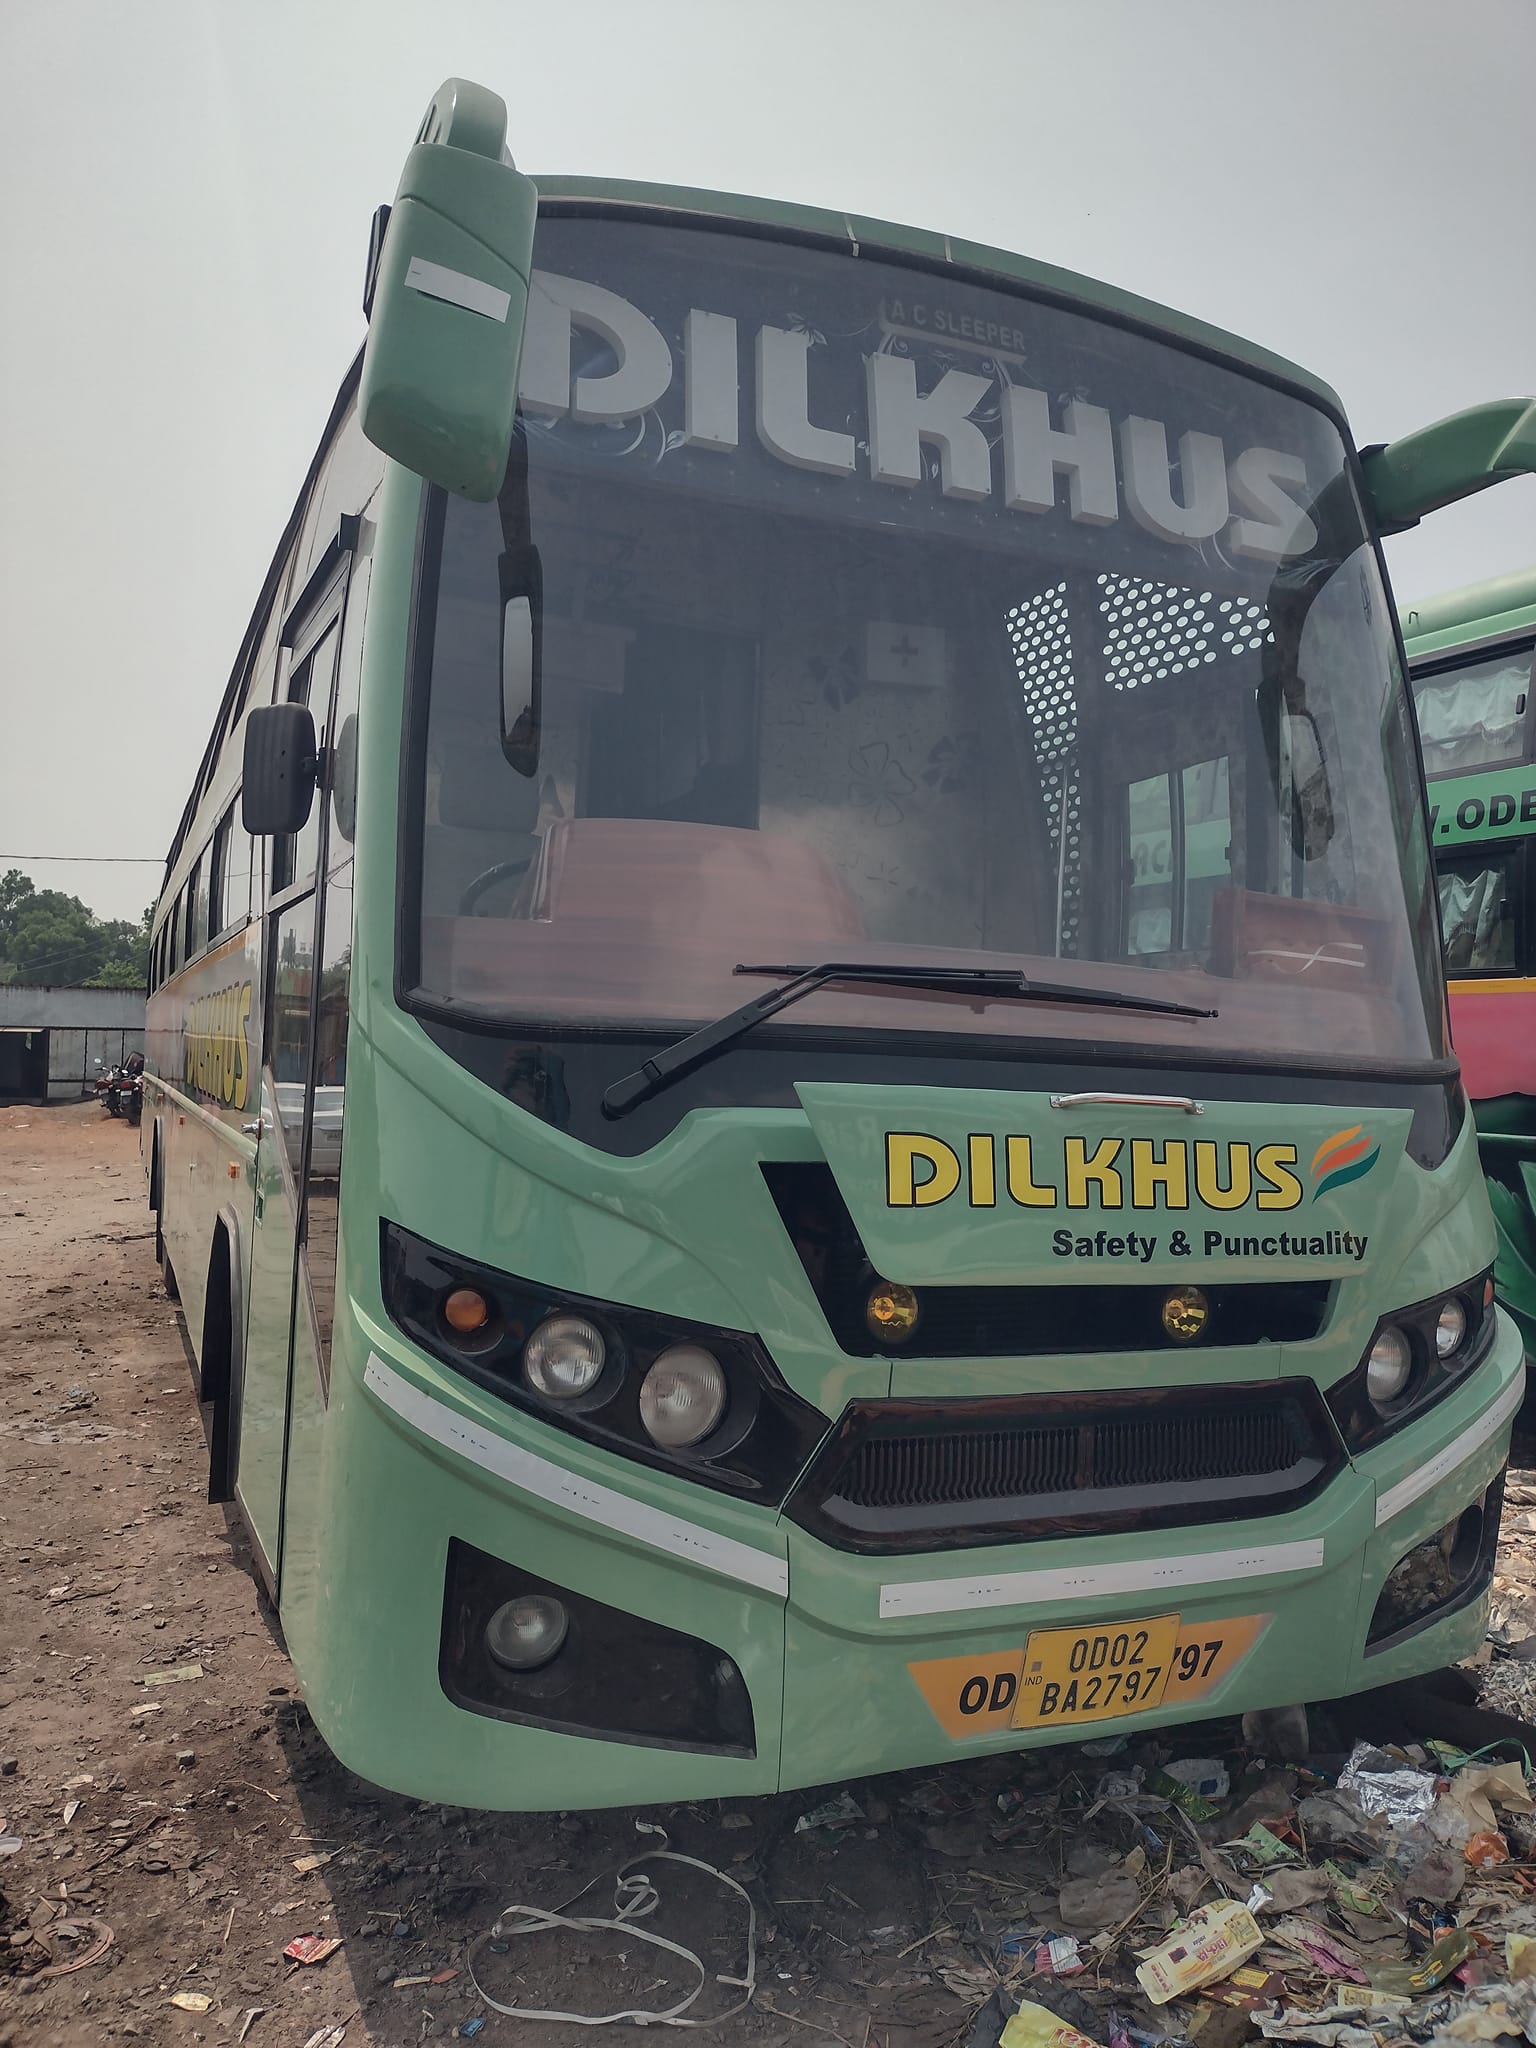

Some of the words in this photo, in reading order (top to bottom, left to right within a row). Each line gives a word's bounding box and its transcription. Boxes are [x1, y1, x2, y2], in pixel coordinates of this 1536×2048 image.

[935, 309, 1026, 351] SLEEPER
[519, 268, 1319, 558] DILKHUS
[885, 1131, 1304, 1211] DILKHUS
[1052, 1229, 1157, 1263] Safety
[1168, 1230, 1192, 1257] &
[1203, 1229, 1369, 1261] Punctuality
[1068, 1630, 1150, 1674] OD02
[1023, 1675, 1043, 1687] IND
[1038, 1666, 1163, 1717] BA2797
